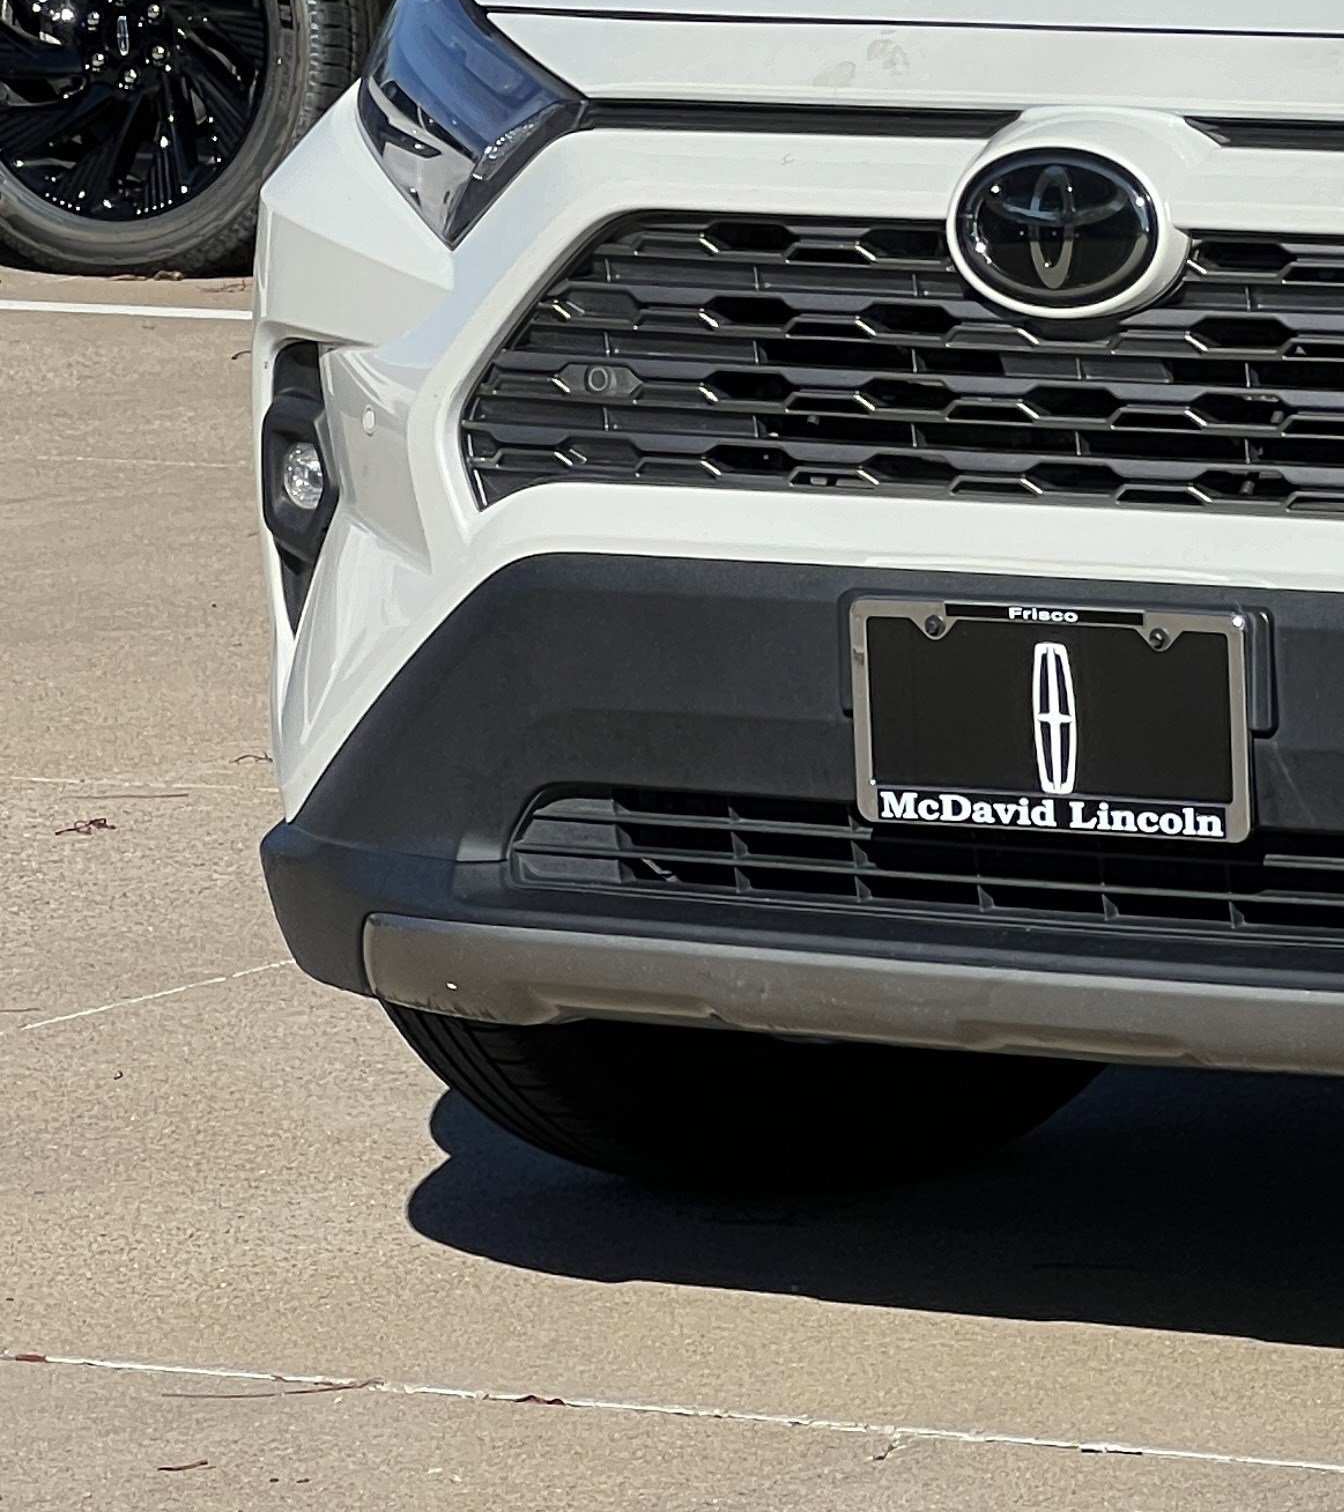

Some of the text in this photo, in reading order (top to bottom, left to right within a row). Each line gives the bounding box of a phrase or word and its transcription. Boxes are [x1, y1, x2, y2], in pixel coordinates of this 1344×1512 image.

[1008, 607, 1079, 623] Frisco
[879, 790, 1224, 838] McDavid Lincoln
